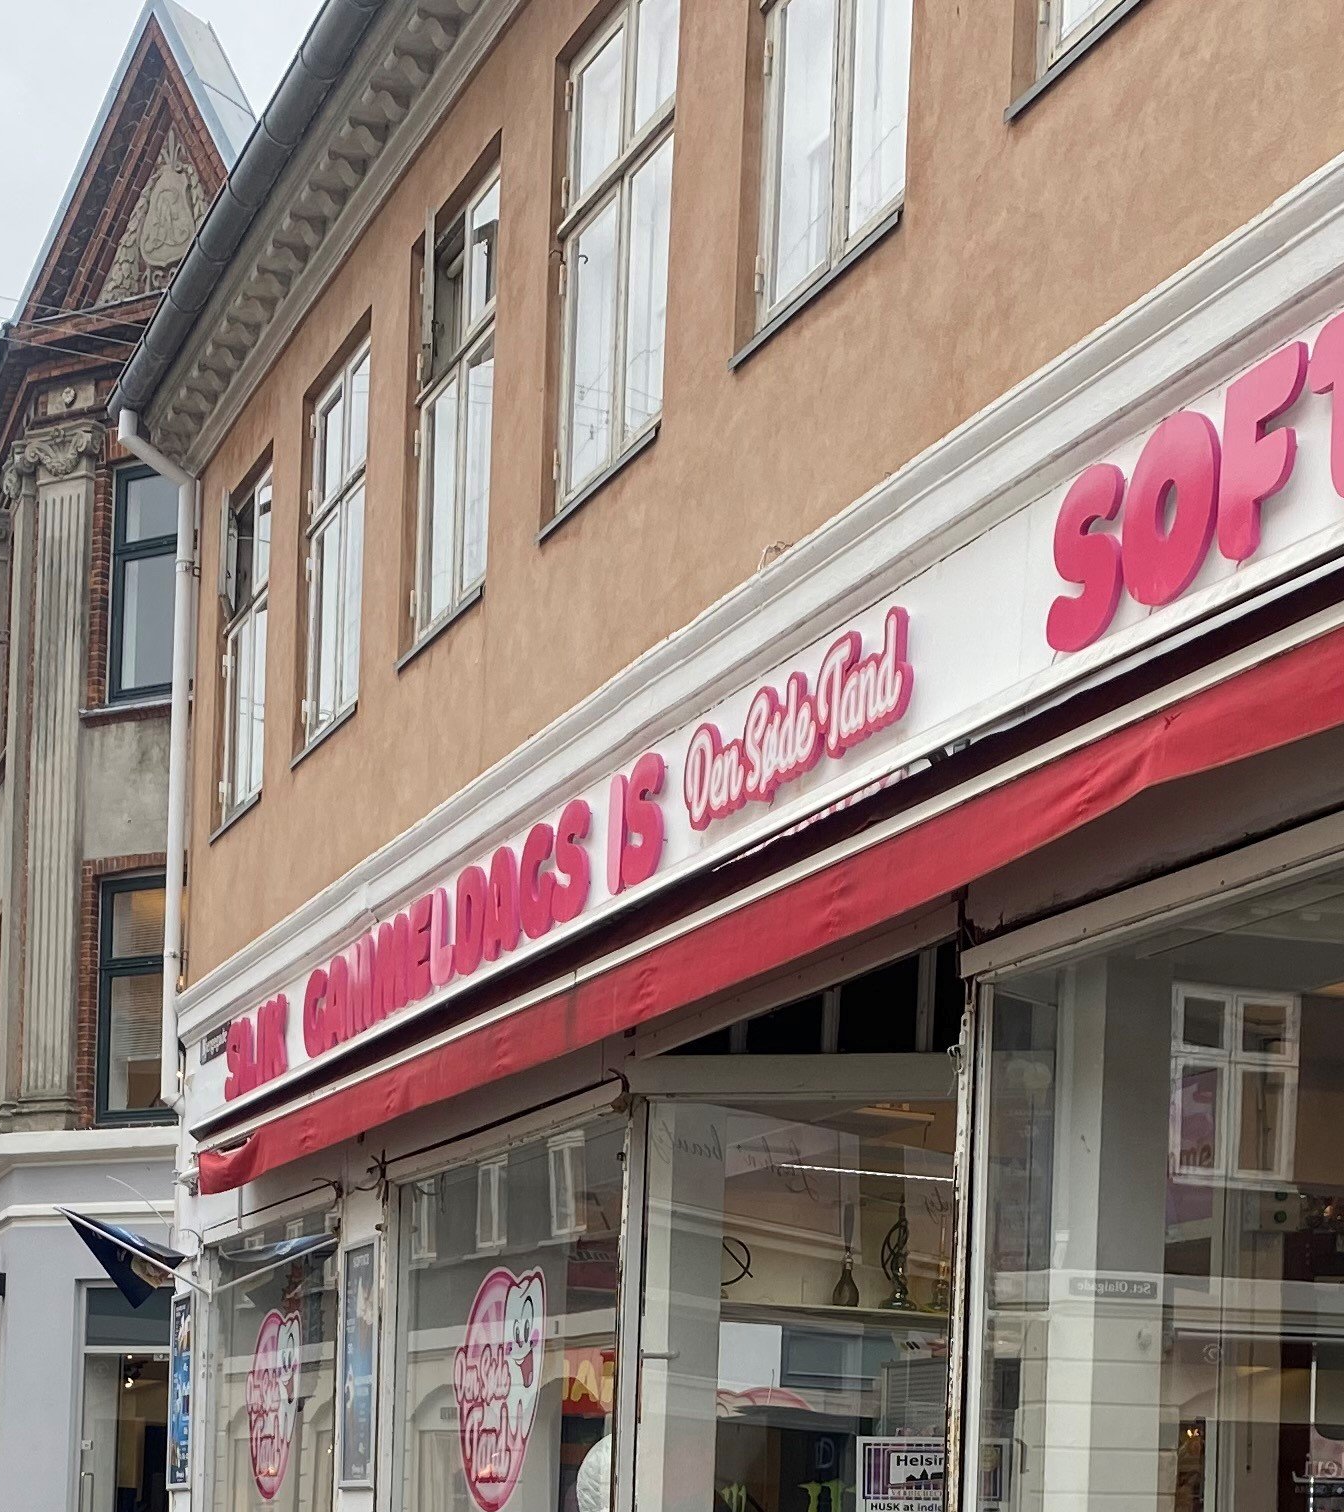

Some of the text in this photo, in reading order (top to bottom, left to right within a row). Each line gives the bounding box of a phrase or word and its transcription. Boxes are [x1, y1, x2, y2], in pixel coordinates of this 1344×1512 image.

[685, 607, 911, 828] Den Søde Tand
[225, 752, 666, 1102] SLIK GAMMELDAGS IS
[870, 1502, 900, 1512] HUSK
[903, 1502, 914, 1512] at
